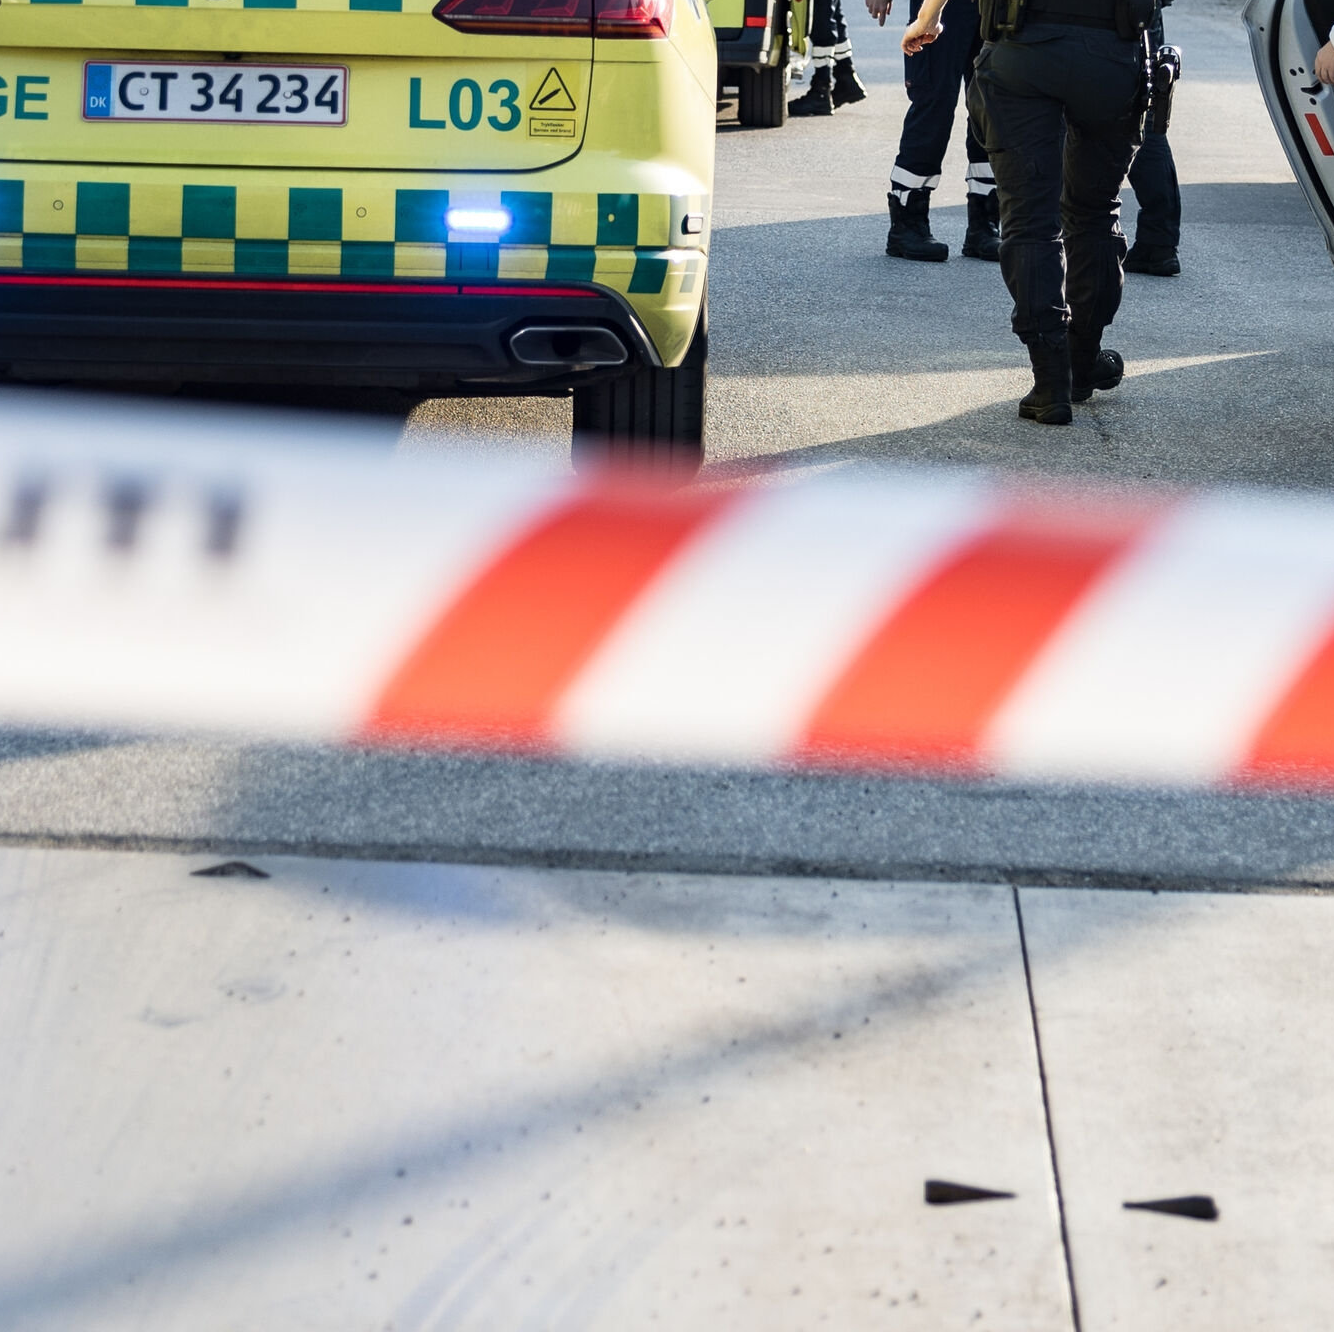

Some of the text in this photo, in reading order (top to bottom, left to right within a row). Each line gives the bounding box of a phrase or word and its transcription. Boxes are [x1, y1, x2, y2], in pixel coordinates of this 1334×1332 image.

[89, 71, 339, 115] DK CT 34 234
[409, 77, 522, 131] L03
